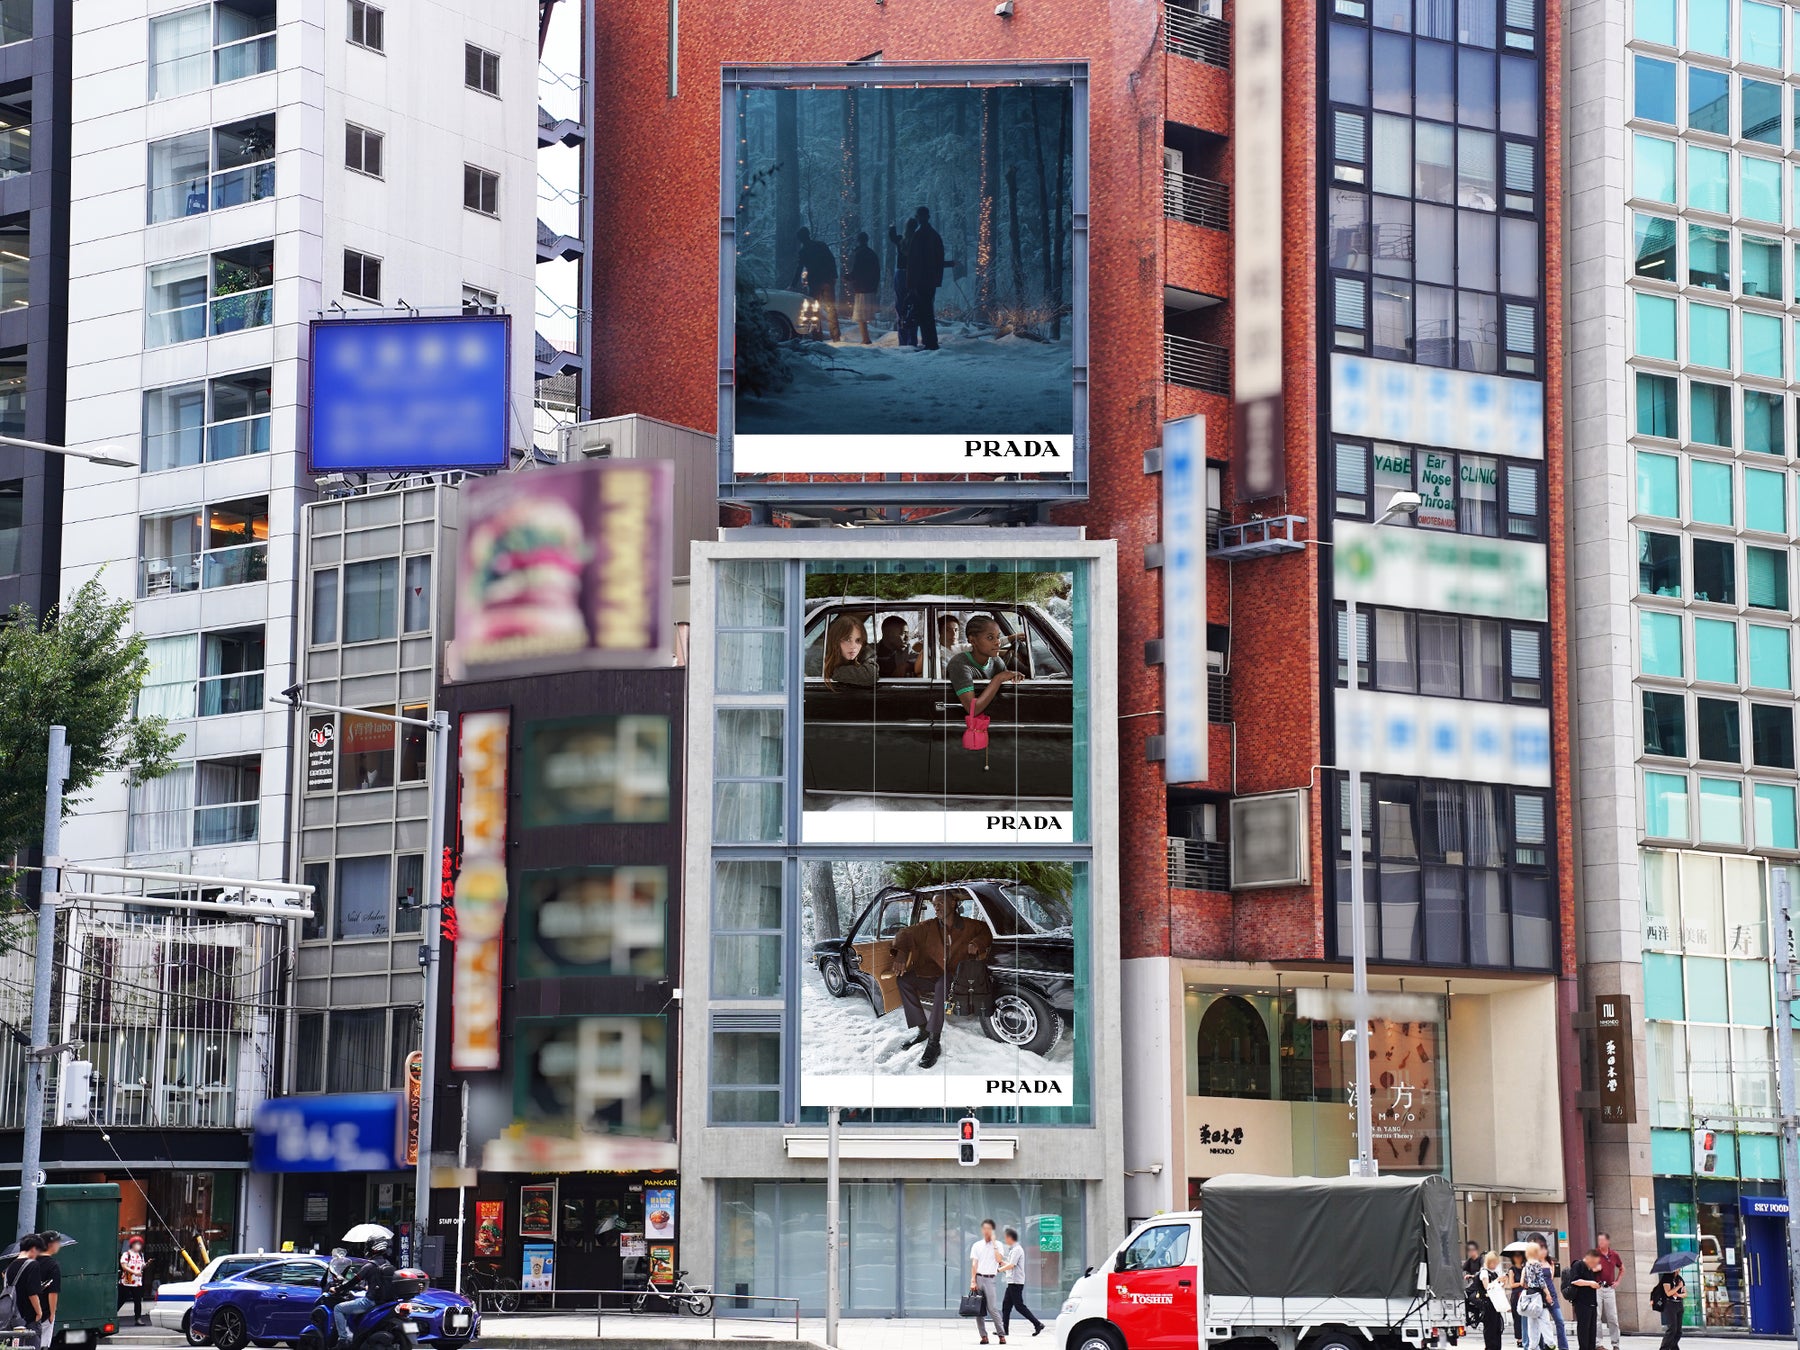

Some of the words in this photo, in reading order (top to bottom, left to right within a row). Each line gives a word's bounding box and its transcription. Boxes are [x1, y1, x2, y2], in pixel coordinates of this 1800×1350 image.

[964, 440, 1060, 457] PRADA
[1375, 455, 1411, 474] YABE
[1426, 454, 1446, 469] Ear
[1422, 469, 1452, 486] Nose
[1460, 465, 1497, 485] CLINIC
[1433, 485, 1441, 497] &
[1418, 493, 1456, 511] Throat
[986, 816, 1062, 829] PRADA
[1646, 925, 1669, 941] 西洋
[986, 1080, 1062, 1093] PRADA
[1348, 1112, 1416, 1121] KMPO
[1393, 1132, 1414, 1140] Theory
[644, 1179, 677, 1187] PANCAKE
[1754, 1203, 1769, 1212] SKY
